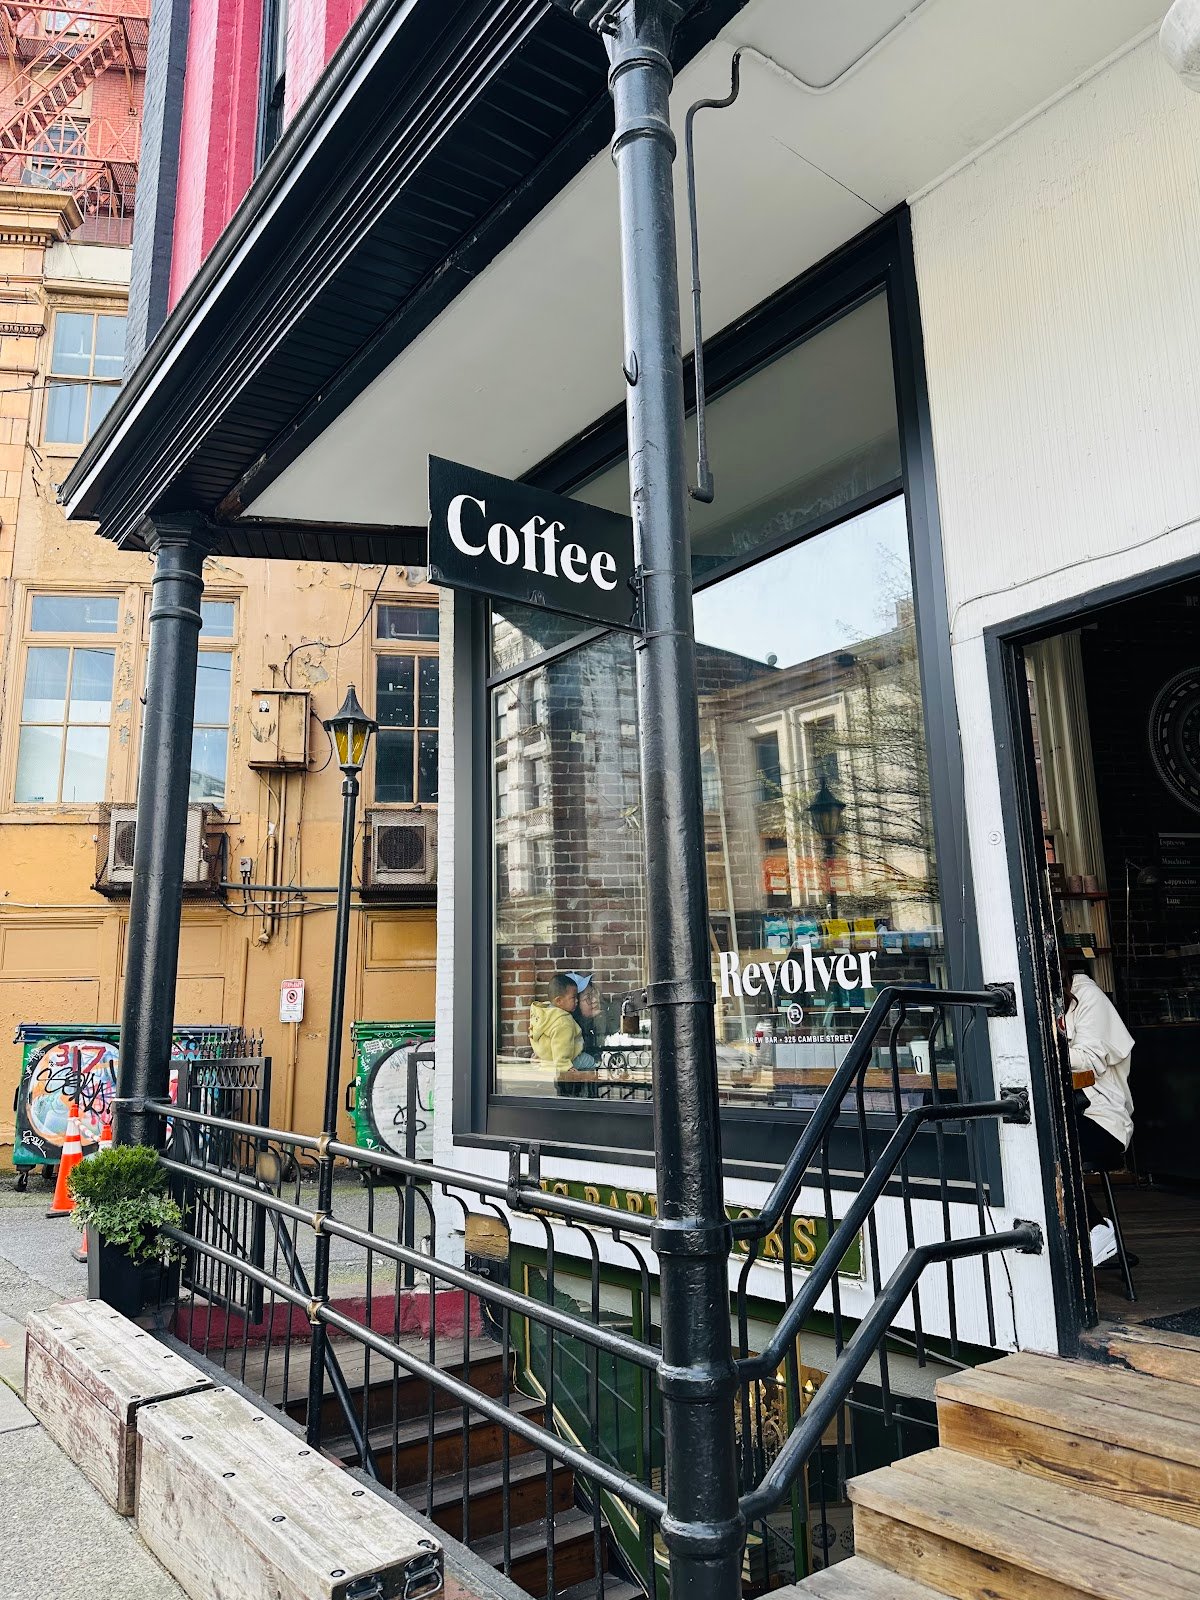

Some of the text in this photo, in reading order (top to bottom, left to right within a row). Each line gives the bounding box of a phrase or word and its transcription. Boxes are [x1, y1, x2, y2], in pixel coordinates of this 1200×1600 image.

[447, 494, 618, 591] Coffee
[718, 943, 877, 997] Revolver
[797, 1035, 824, 1043] CAMBIE
[826, 1034, 853, 1042] STREET
